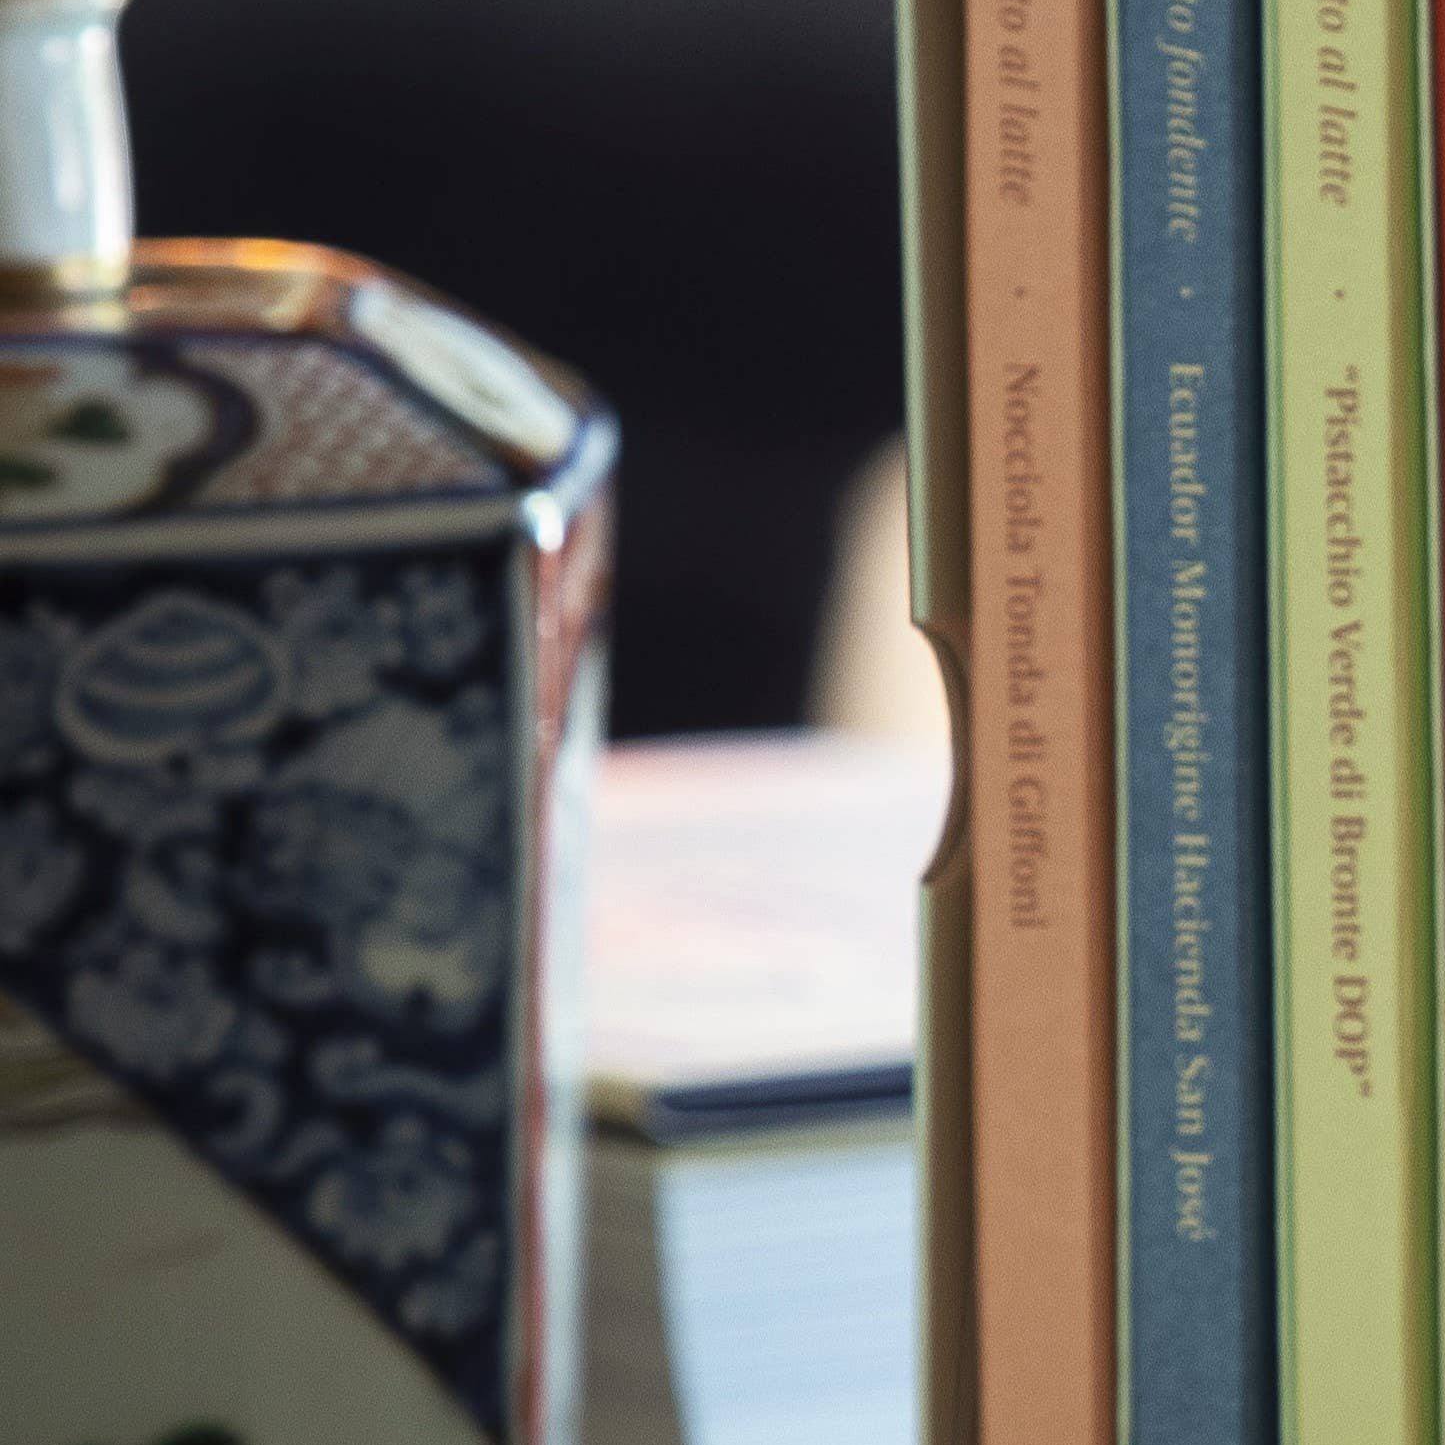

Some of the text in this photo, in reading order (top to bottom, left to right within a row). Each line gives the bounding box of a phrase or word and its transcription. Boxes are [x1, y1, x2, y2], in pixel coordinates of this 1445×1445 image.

[998, 45, 1040, 90] al
[1317, 46, 1359, 90] al
[999, 103, 1039, 206] latte
[1156, 37, 1207, 243] fondente
[1318, 104, 1358, 207] latte
[1005, 364, 1042, 553] Nocciola
[1167, 364, 1206, 543] Ecuador
[1007, 569, 1042, 706] Tonda
[1163, 561, 1210, 821] Monorigine
[1329, 619, 1366, 745] Verde
[1008, 721, 1045, 760] di
[1330, 757, 1368, 799] di
[1007, 778, 1046, 928] Giffoni
[1330, 815, 1368, 960] Bronte
[1173, 834, 1213, 1041] Hacienda
[1176, 1055, 1212, 1135] San
[1169, 1147, 1216, 1241] José
